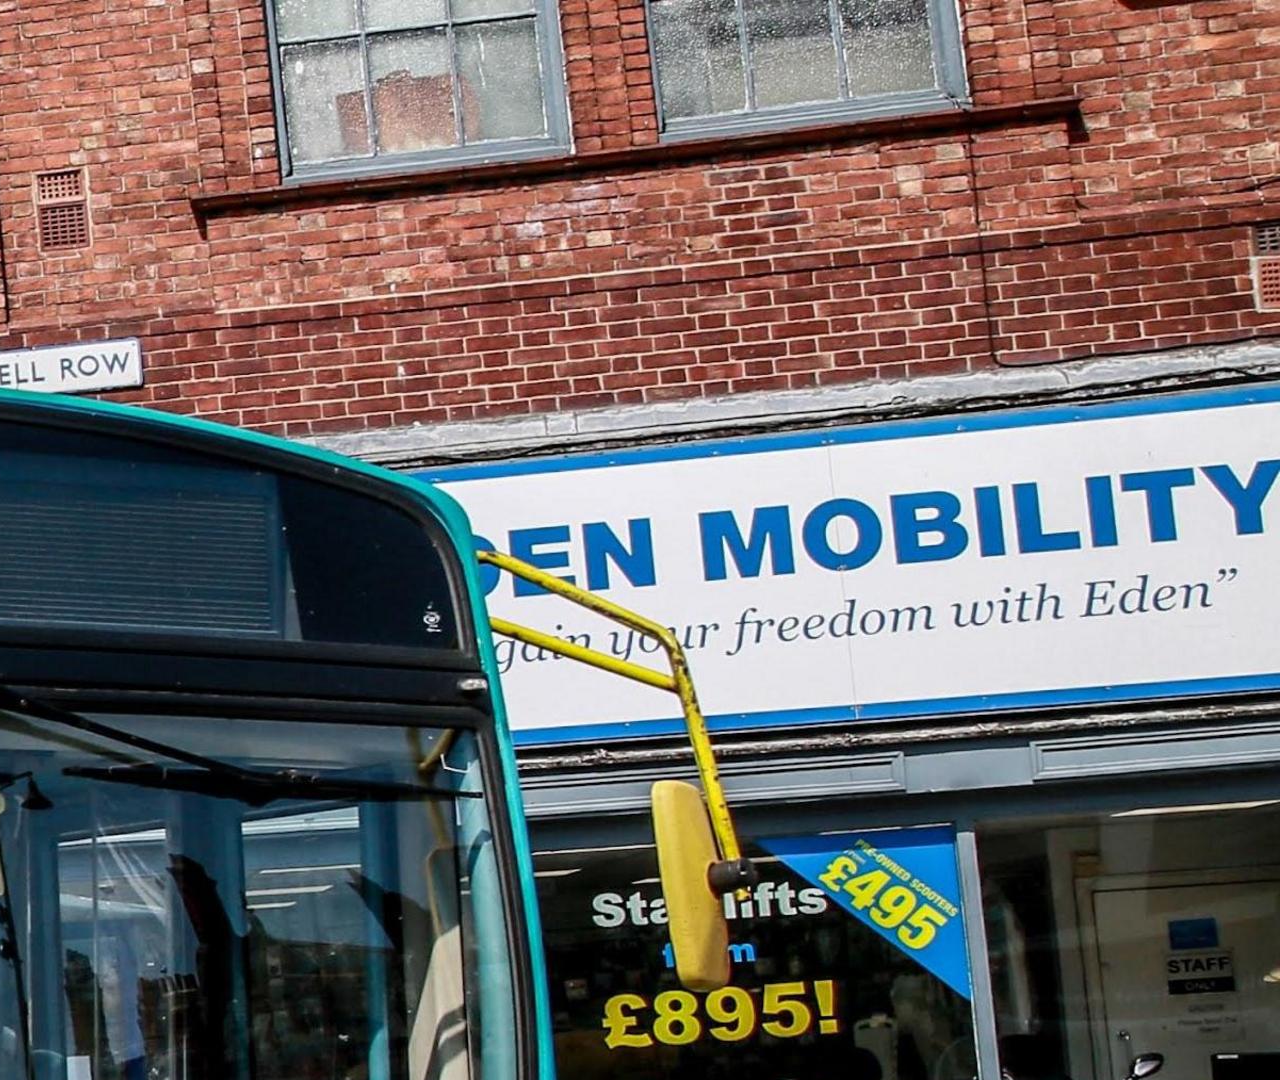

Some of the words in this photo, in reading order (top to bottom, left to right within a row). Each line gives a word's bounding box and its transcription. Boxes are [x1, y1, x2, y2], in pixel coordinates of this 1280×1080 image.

[60, 352, 130, 381] ROW
[698, 459, 1280, 581] MOBILITY
[608, 626, 720, 661] your
[726, 599, 935, 656] freedom
[952, 582, 1063, 628] with
[592, 881, 828, 928] Stalifts
[819, 855, 949, 950] £495
[909, 877, 959, 918] SCOOTERS
[662, 942, 757, 968] fm
[1167, 956, 1230, 974] STAFF
[602, 979, 839, 1049] £895!
